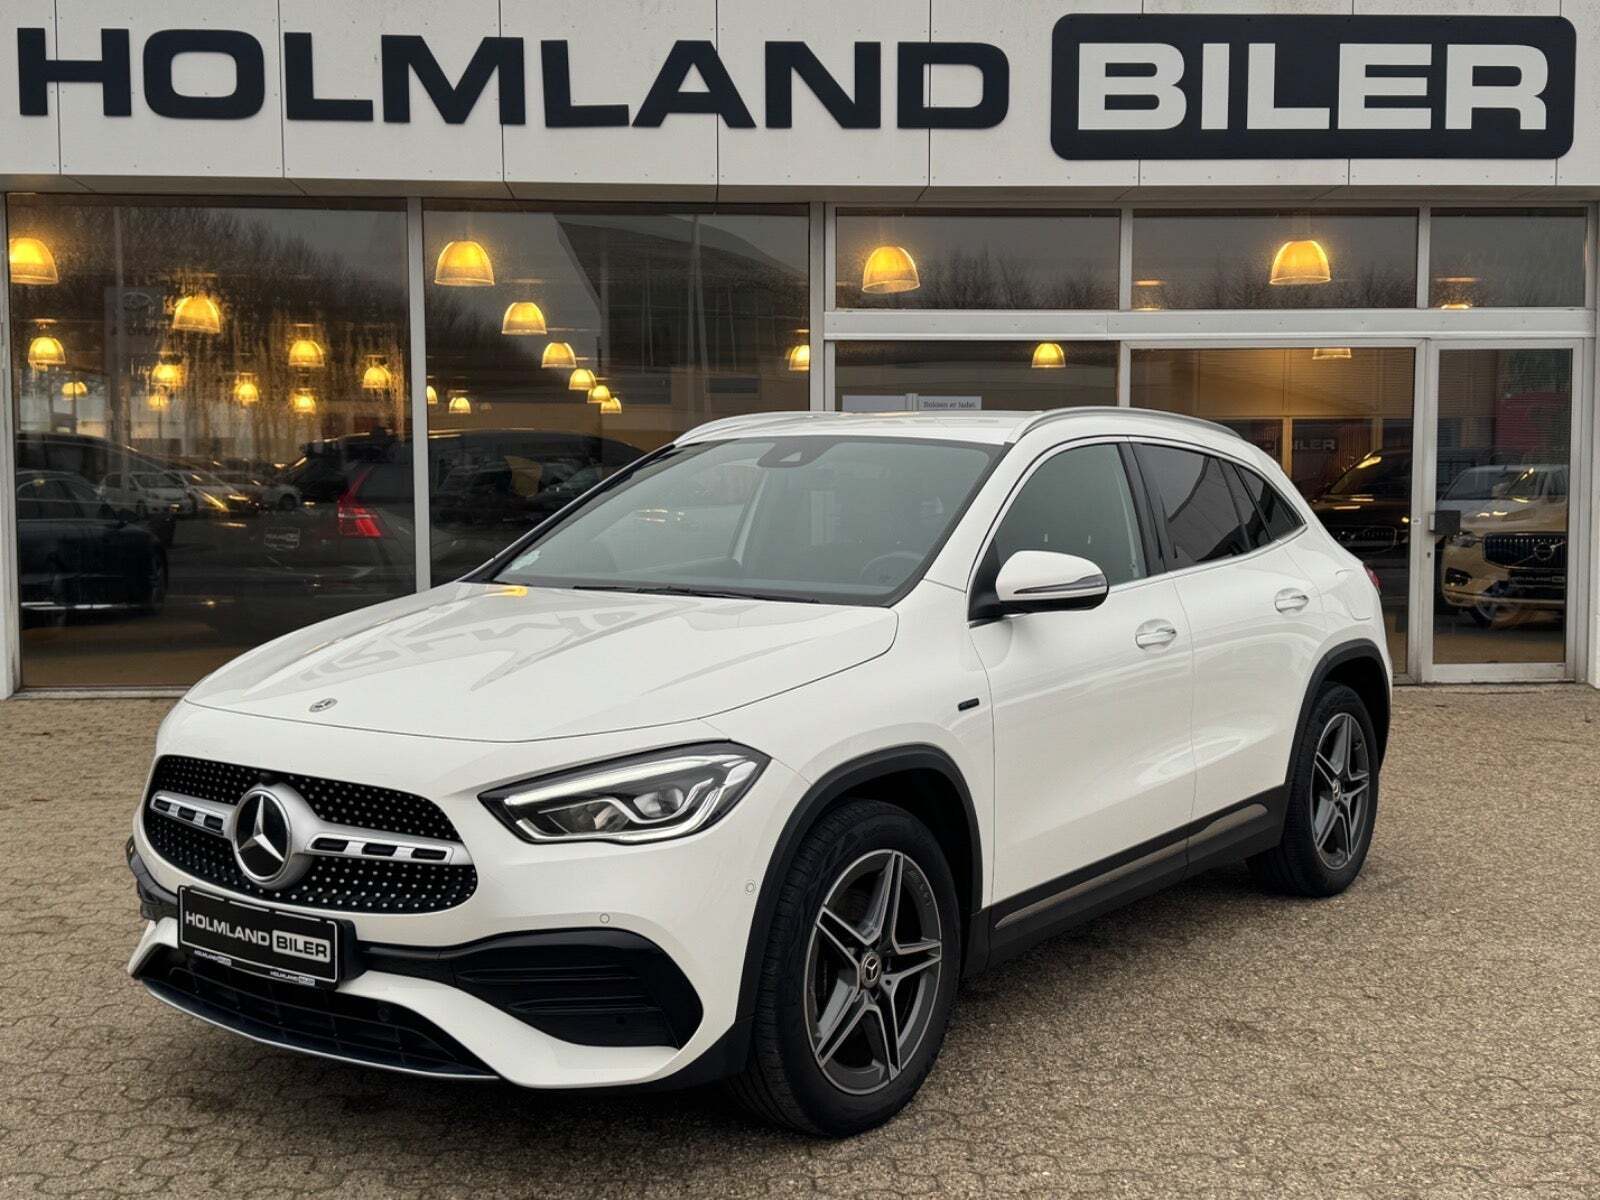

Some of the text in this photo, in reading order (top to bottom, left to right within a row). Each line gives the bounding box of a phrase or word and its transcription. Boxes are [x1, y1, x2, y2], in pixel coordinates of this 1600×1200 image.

[17, 28, 1548, 131] HOLMLAND BILER
[185, 910, 328, 958] HOLMLAND BILER
